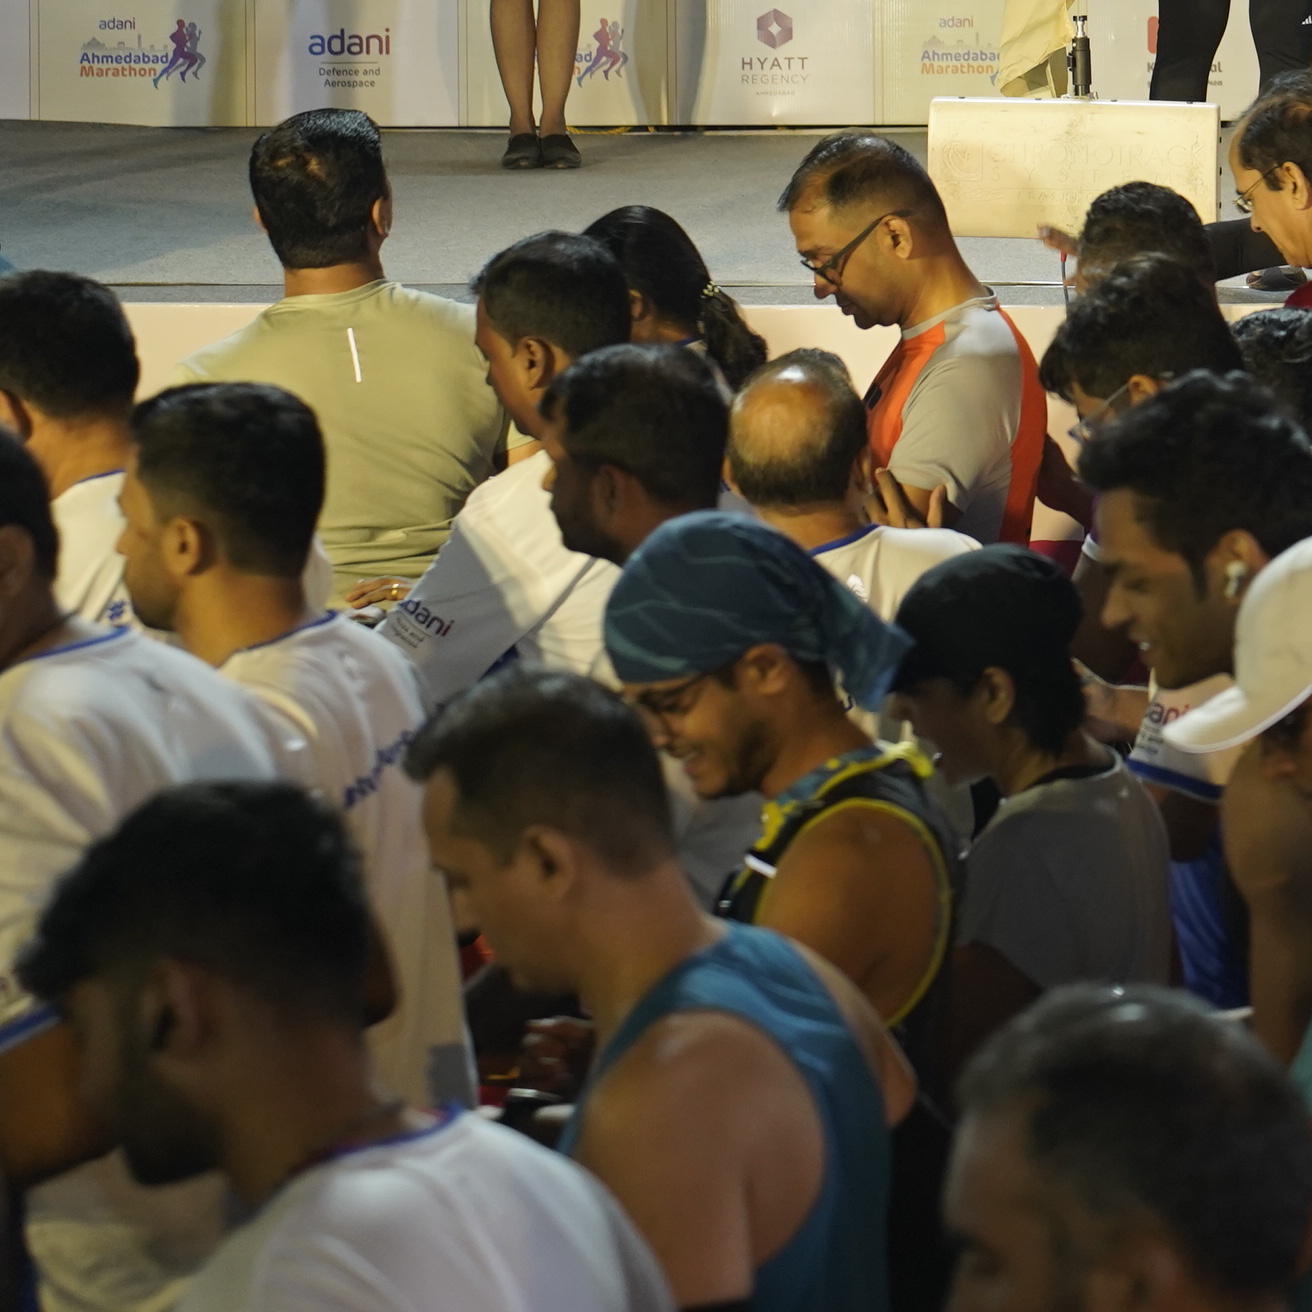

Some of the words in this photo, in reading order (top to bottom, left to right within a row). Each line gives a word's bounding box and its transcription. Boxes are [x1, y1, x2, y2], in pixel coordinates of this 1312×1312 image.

[99, 17, 136, 31] adani
[938, 15, 974, 29] adani
[308, 28, 391, 56] adani
[79, 51, 169, 66] Ahmedabad
[741, 57, 809, 71] HYATT
[79, 64, 157, 79] Marathon
[318, 67, 359, 77] Defence
[362, 67, 381, 77] and
[920, 62, 995, 76] Marathon
[323, 78, 376, 89] Aerospace
[741, 74, 809, 85] REGENCY
